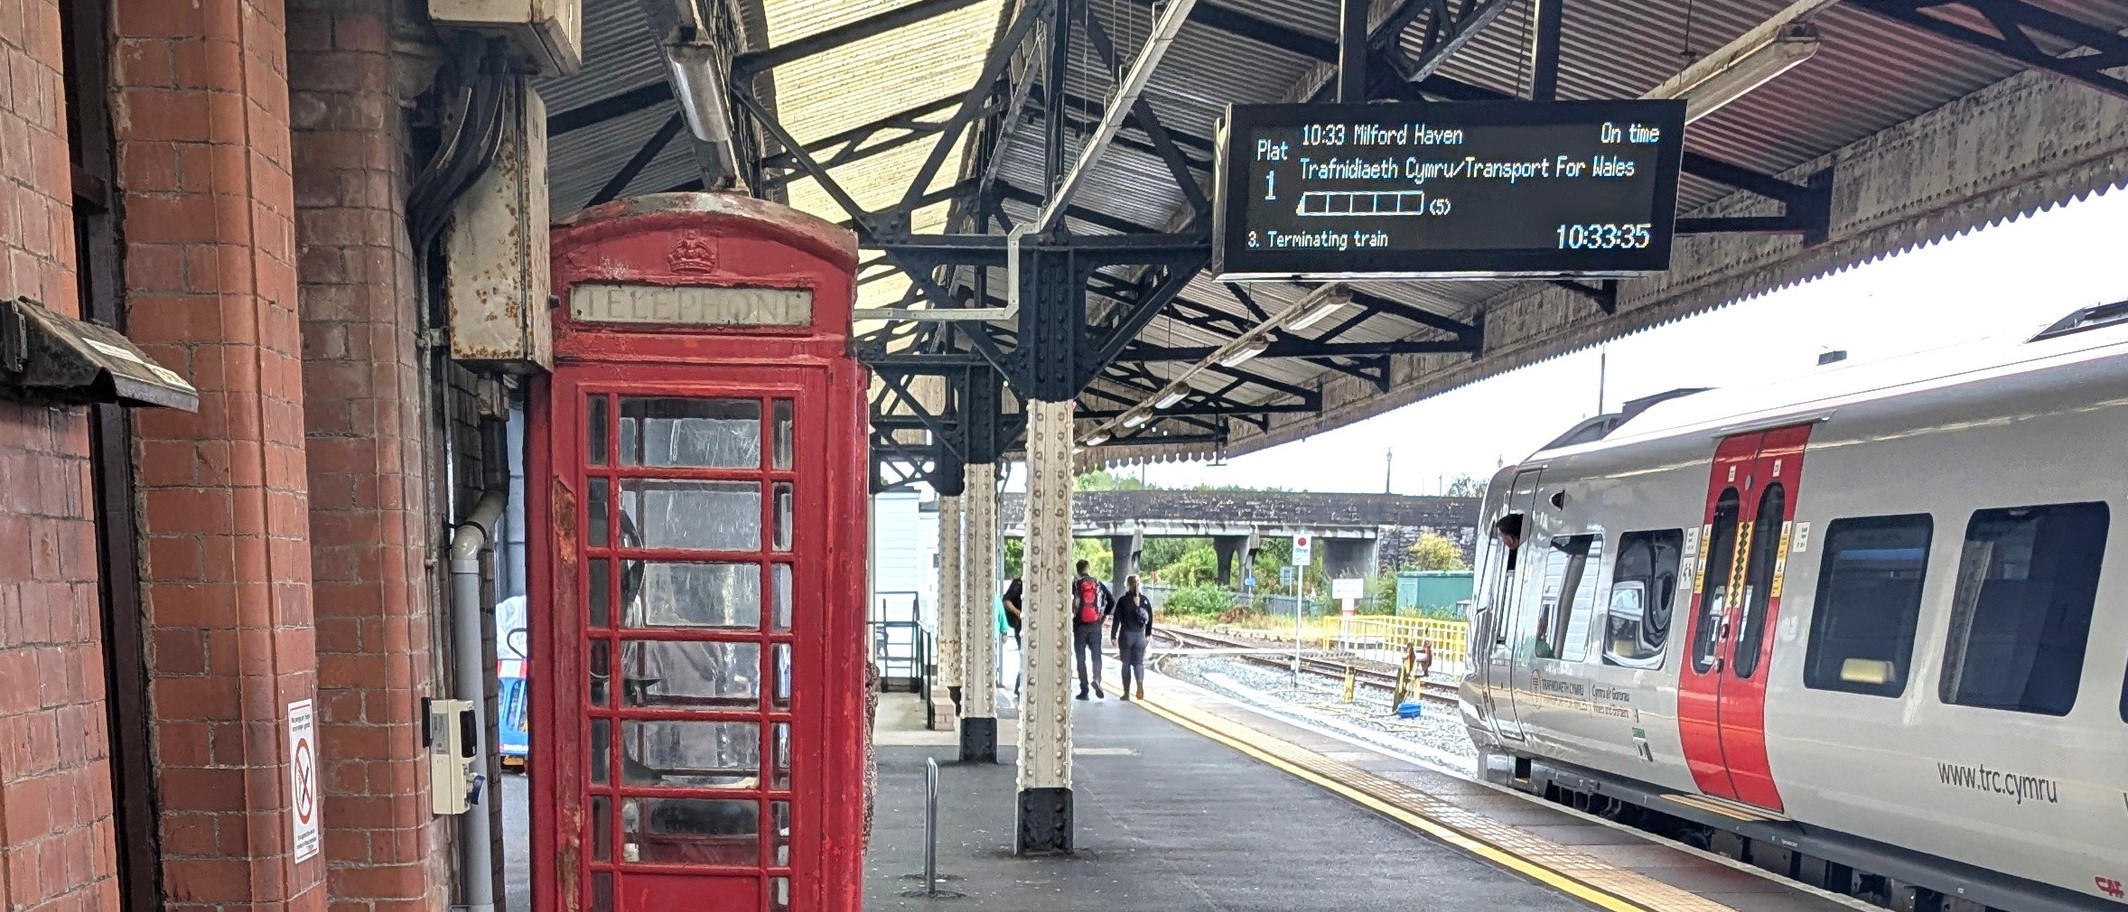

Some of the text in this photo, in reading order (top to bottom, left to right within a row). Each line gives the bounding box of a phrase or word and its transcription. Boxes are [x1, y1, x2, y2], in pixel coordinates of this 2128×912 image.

[1302, 123, 1463, 146] 10:33 Milford Haven
[1601, 121, 1660, 144] On time
[1257, 139, 1289, 161] Plat
[1300, 155, 1635, 185] Trafnidiaeth Cymru/Transport For Wales
[1265, 170, 1277, 201] 1
[1429, 198, 1451, 216] (5)
[1248, 229, 1389, 252] 3. Terminating train
[1556, 222, 1652, 250] 10:33:35
[583, 289, 803, 323] TELEPHONE
[1937, 761, 2058, 805] www.trc.cymru
